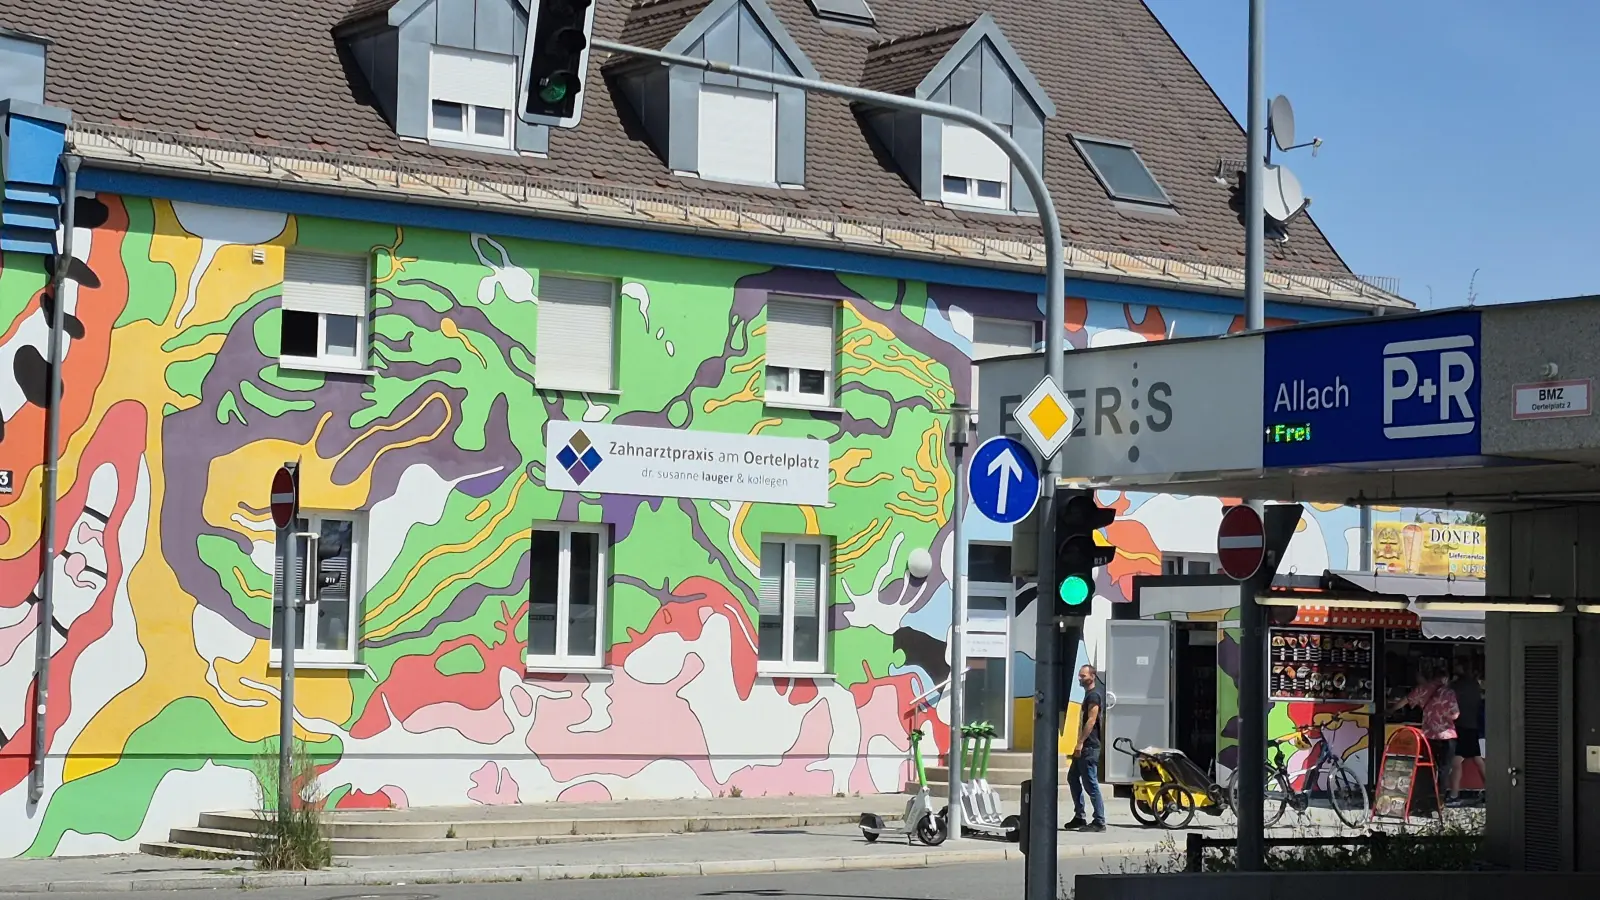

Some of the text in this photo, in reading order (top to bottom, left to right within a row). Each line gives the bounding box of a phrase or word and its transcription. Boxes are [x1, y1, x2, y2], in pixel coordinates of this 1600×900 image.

[1274, 375, 1349, 412] Allach
[1383, 351, 1475, 424] P+R
[1539, 388, 1564, 401] BMZ
[1531, 401, 1571, 411] Oertelplatz 2
[1275, 422, 1311, 442] Frei
[609, 441, 820, 470] Zahnarztpraxis am Oertelplatz
[641, 467, 788, 488] dr. susanne lauger & kollegen
[1431, 525, 1480, 545] DÖNER
